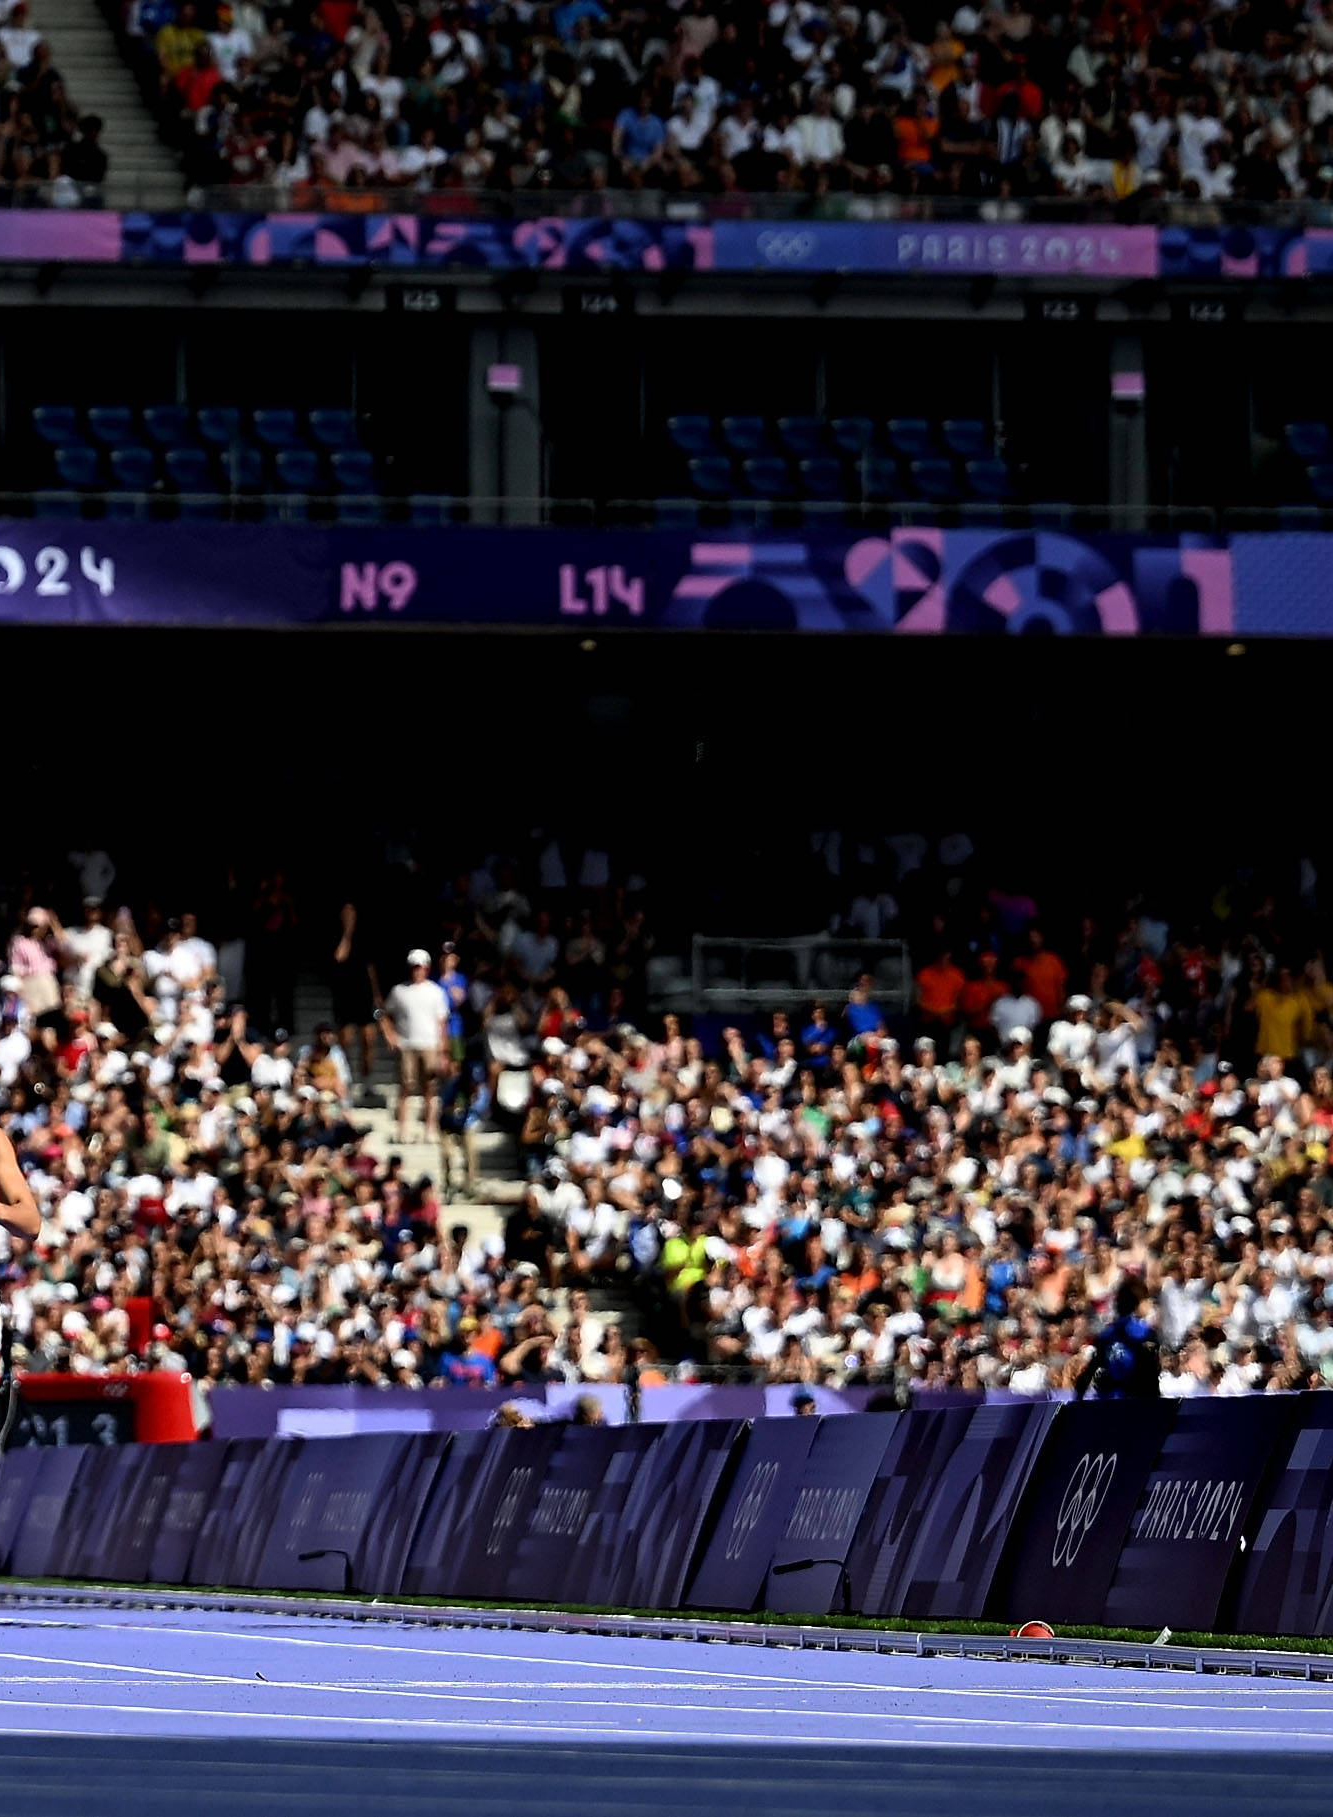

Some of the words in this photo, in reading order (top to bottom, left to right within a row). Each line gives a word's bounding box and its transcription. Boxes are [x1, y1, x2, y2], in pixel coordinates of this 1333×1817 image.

[897, 234, 1008, 266] PARIS
[1019, 235, 1121, 266] 2024
[339, 561, 419, 613] N9
[558, 563, 645, 616] L14
[1135, 1480, 1197, 1540] PARIS
[1185, 1480, 1243, 1541] 2024
